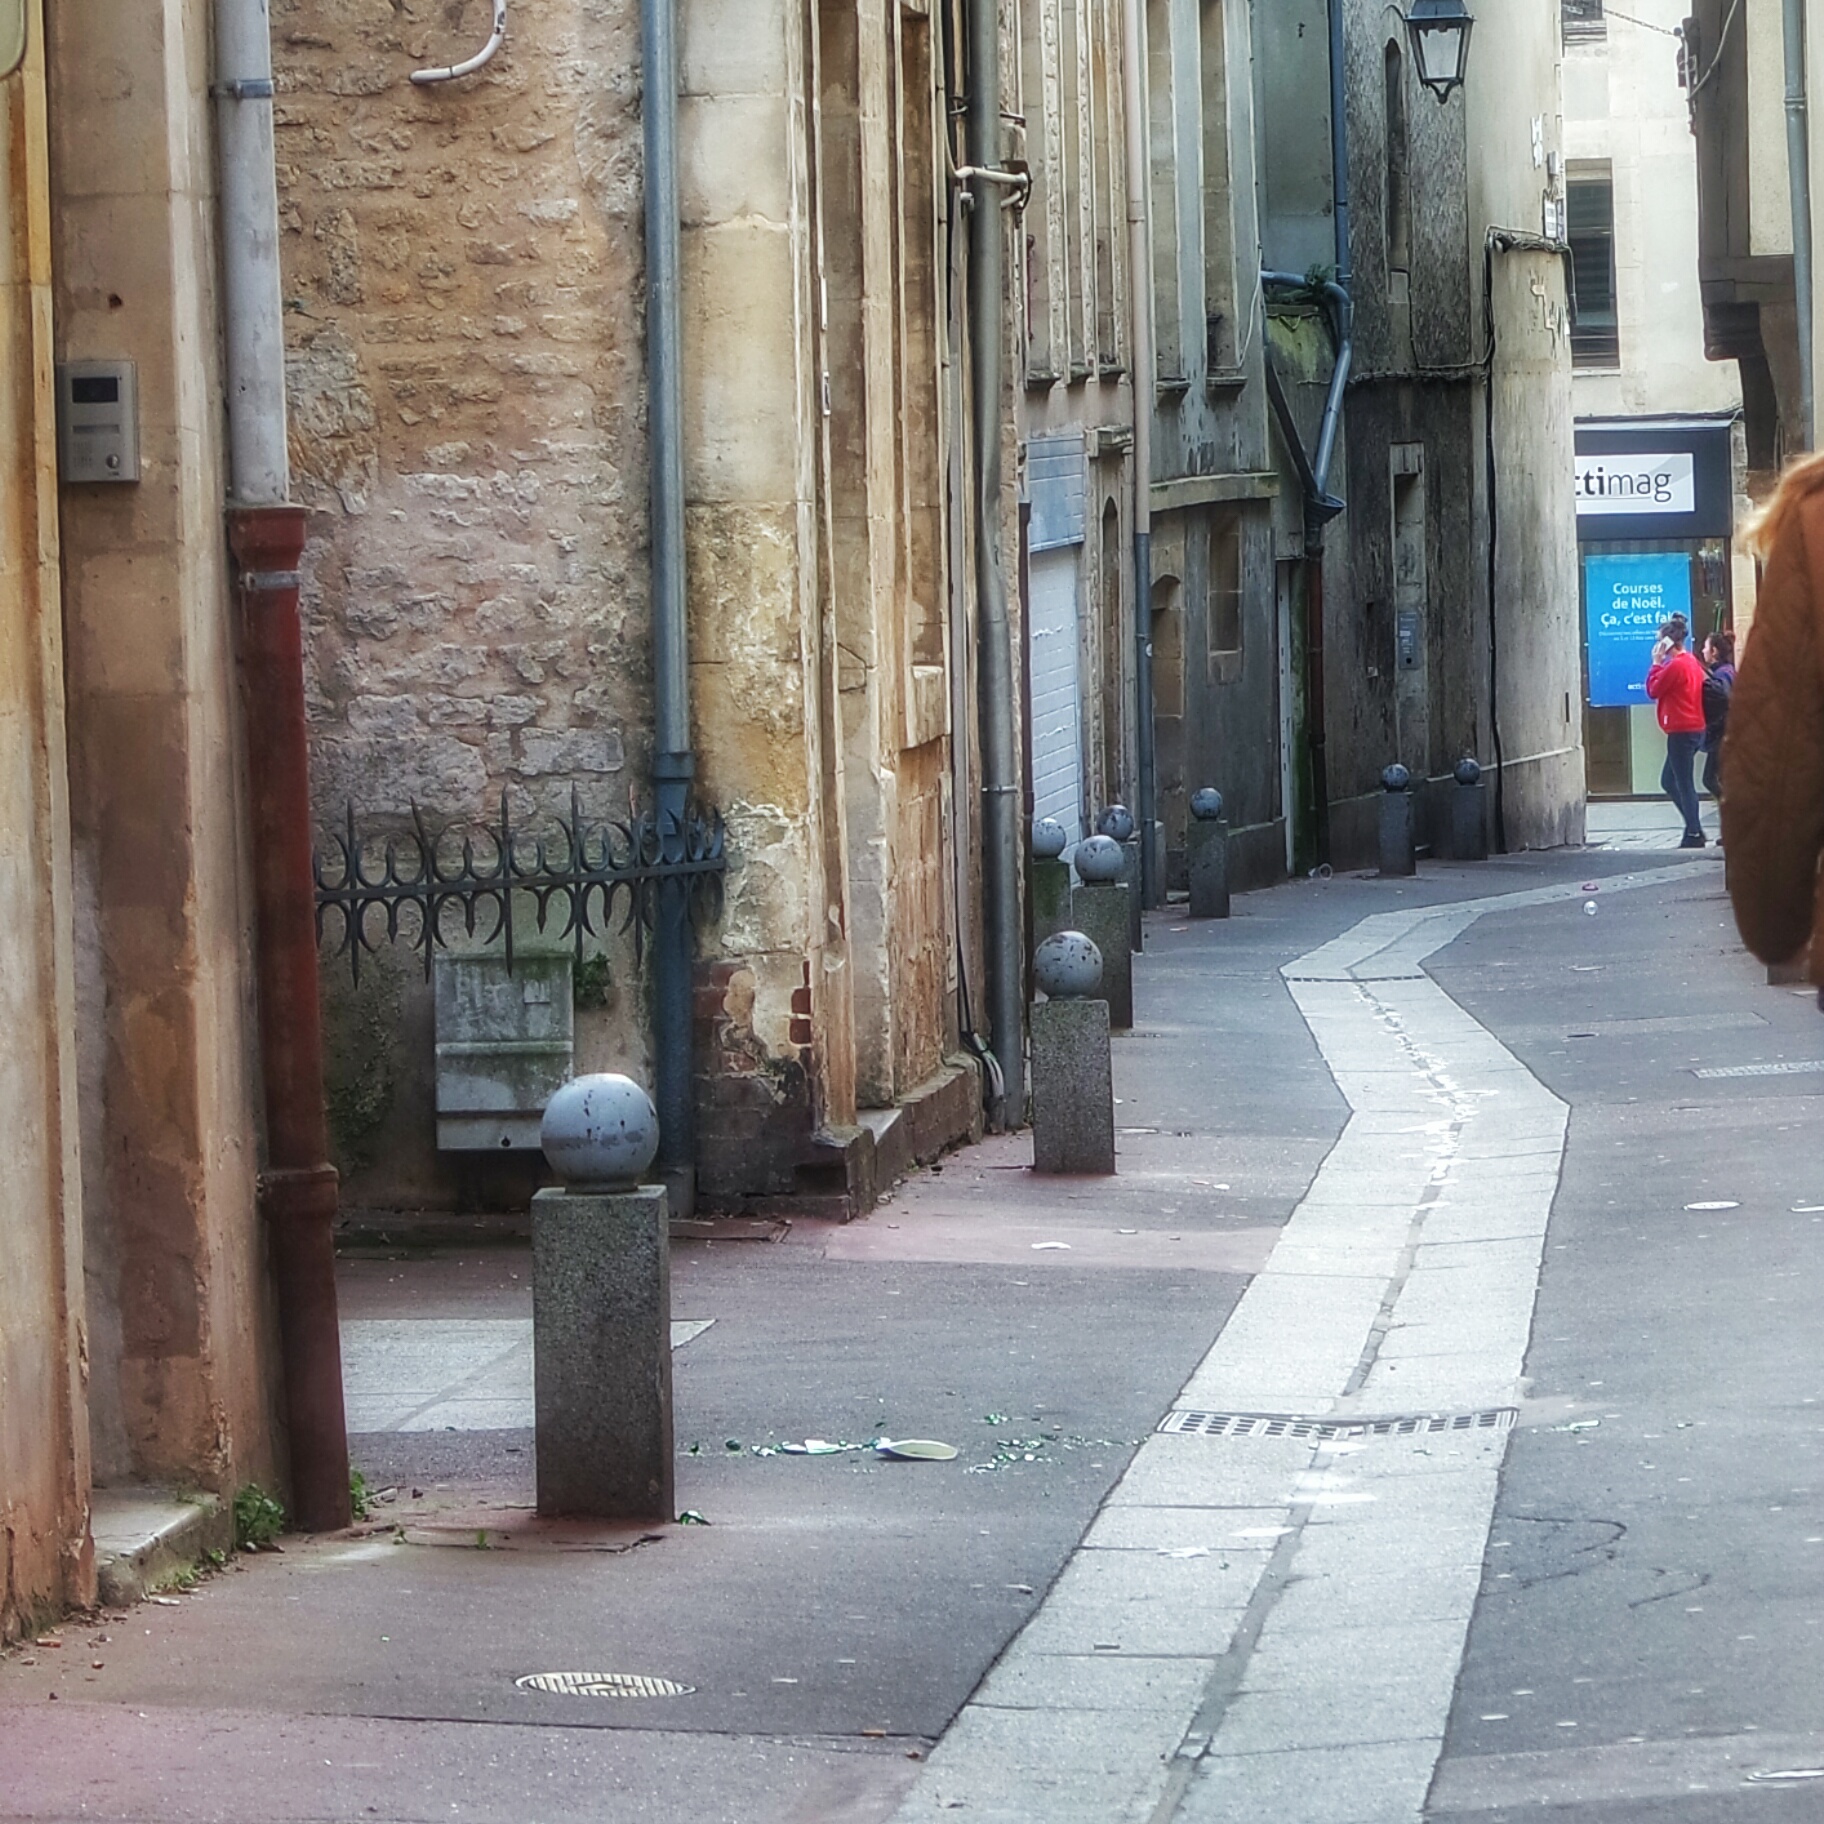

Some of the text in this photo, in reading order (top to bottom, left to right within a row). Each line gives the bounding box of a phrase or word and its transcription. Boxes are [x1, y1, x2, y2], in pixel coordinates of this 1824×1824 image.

[1613, 582, 1664, 595] Courses
[1612, 596, 1665, 609] de Noël.
[1600, 613, 1621, 628] Ça,
